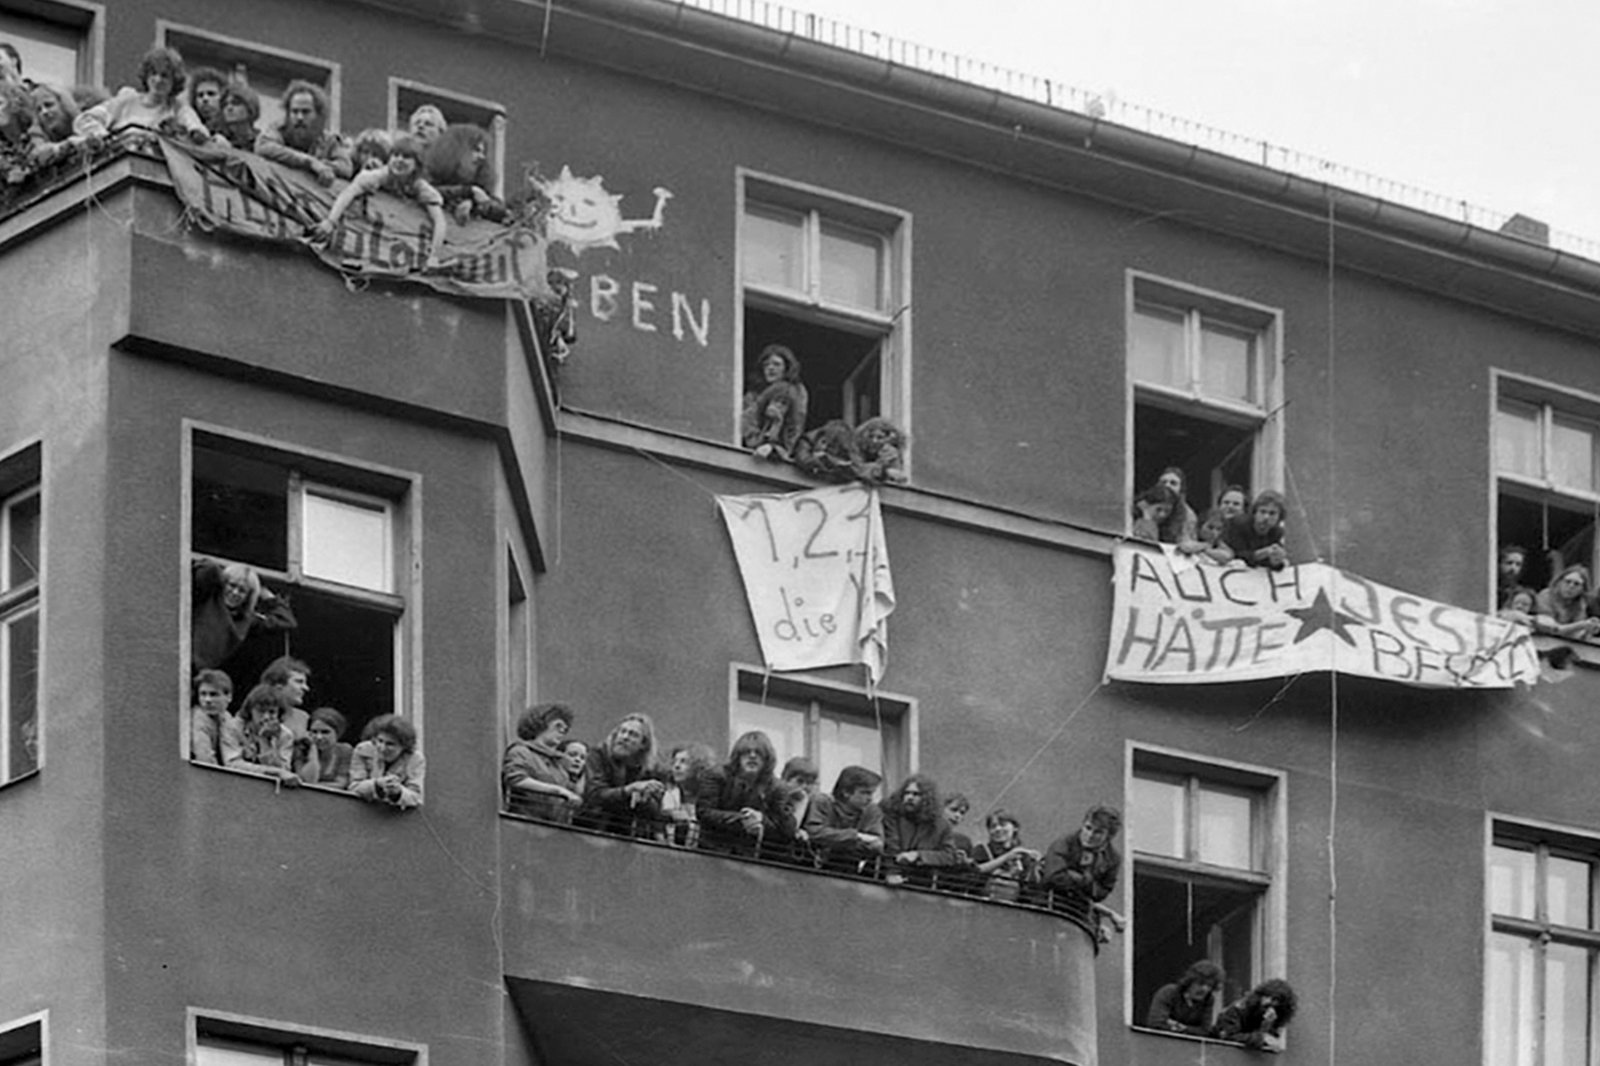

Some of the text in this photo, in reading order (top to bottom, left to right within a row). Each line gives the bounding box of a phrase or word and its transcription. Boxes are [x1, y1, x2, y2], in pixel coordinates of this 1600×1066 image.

[1131, 553, 1301, 606] AUCH
[774, 587, 837, 642] die
[1117, 606, 1287, 671] HÄTTE
